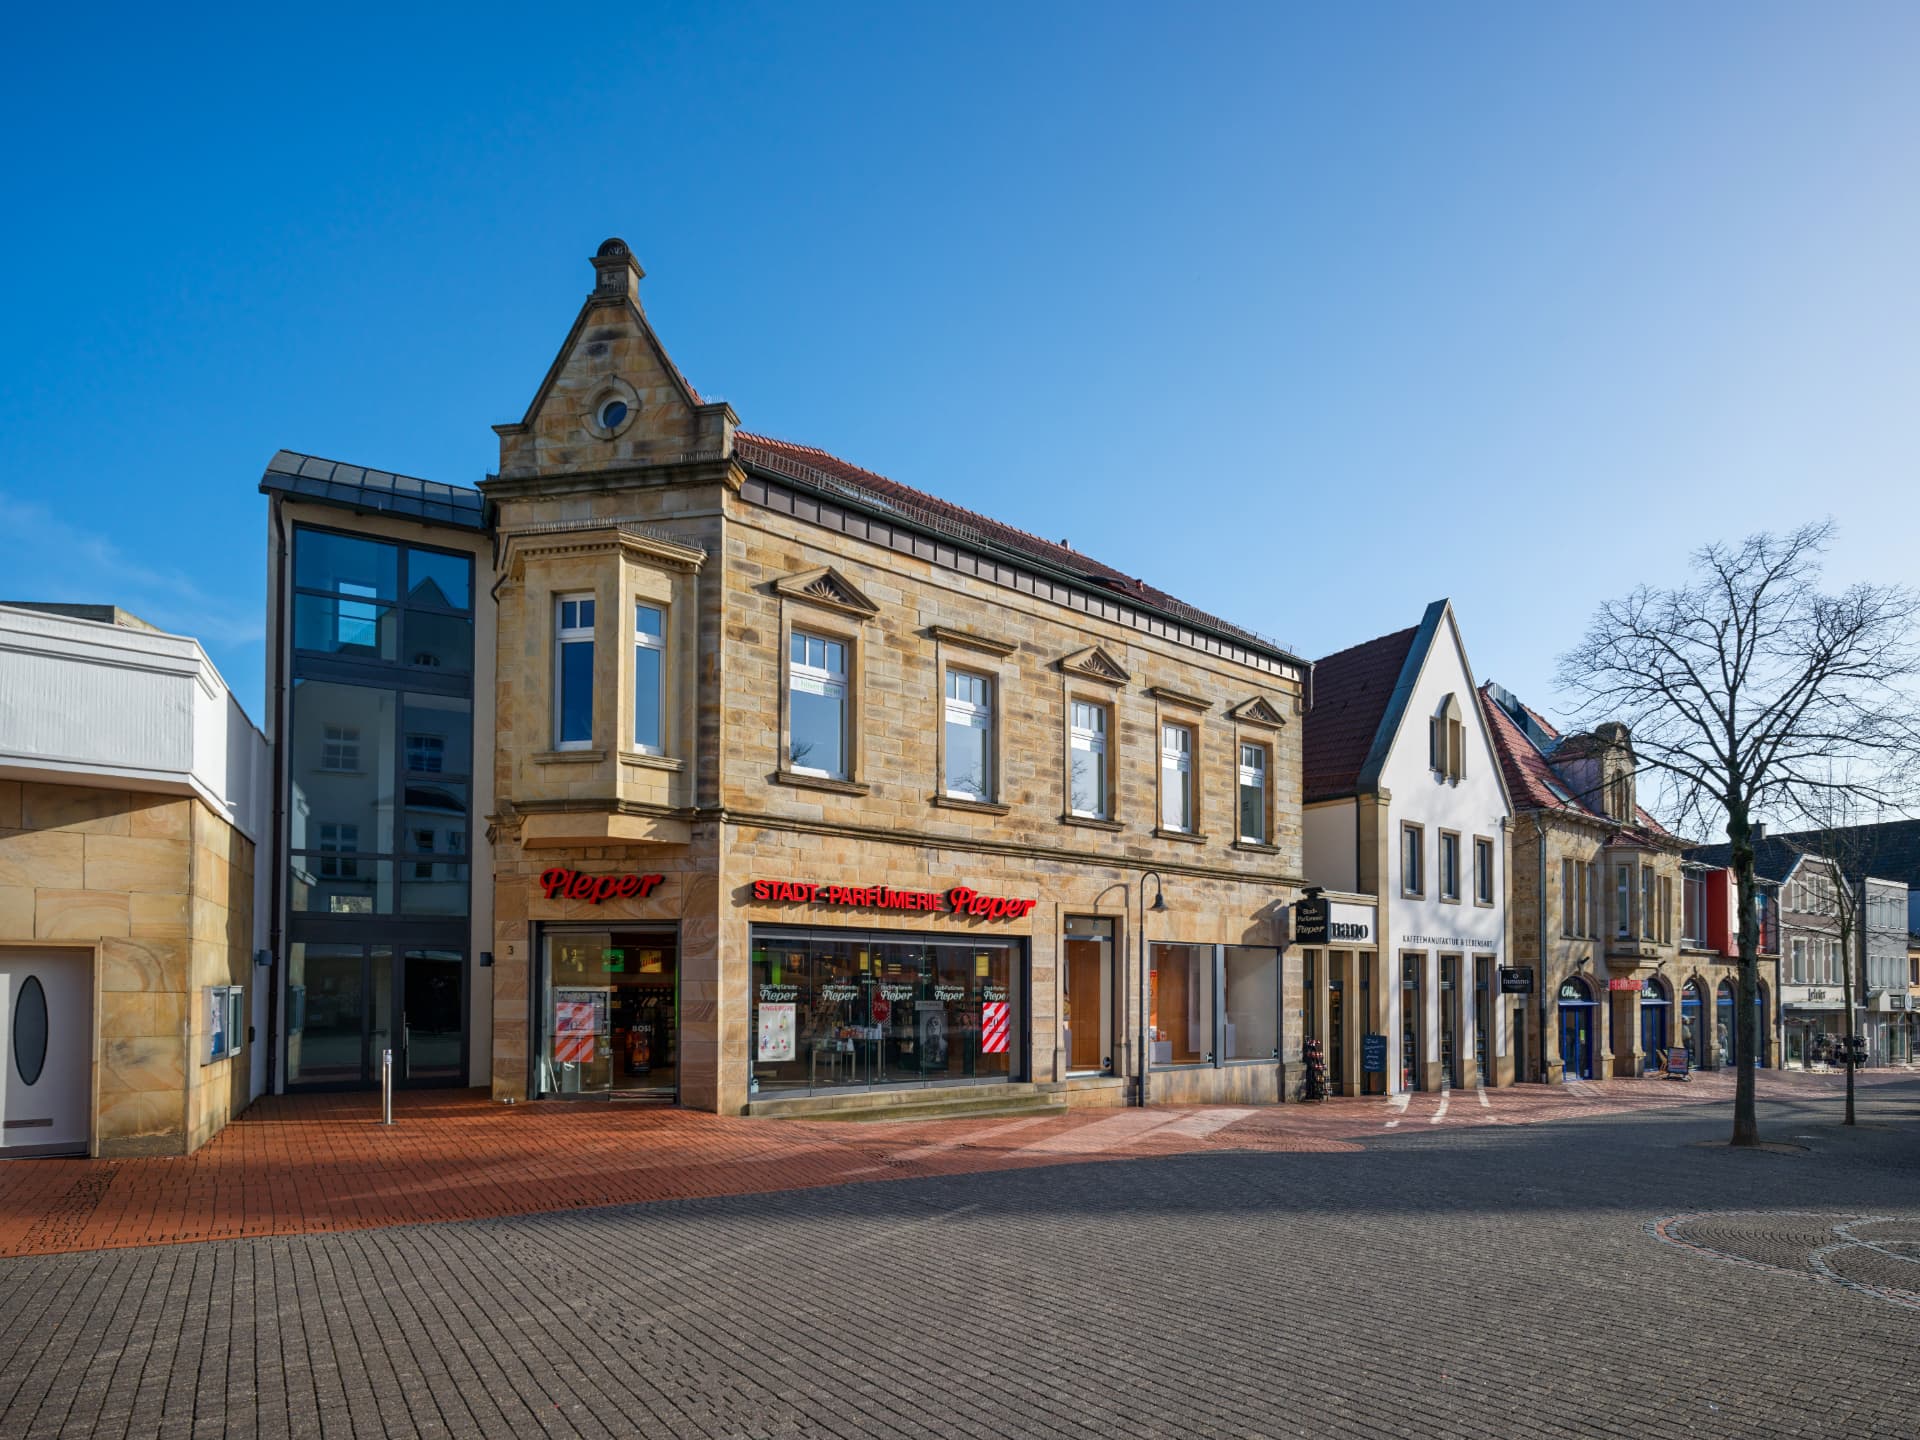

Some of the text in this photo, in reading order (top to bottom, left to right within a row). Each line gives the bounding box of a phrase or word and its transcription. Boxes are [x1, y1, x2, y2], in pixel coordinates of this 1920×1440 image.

[754, 879, 1037, 921] STADT-PARFÜMERIE Pieper
[1402, 935, 1459, 946] KAFFEEMANUFAKTUR
[508, 945, 514, 955] 3
[760, 990, 798, 1002] Pieper
[822, 990, 857, 1001] Pieper
[881, 990, 912, 1001] Pieper
[934, 990, 964, 1001] Pieper
[984, 990, 1008, 1001] Piepe
